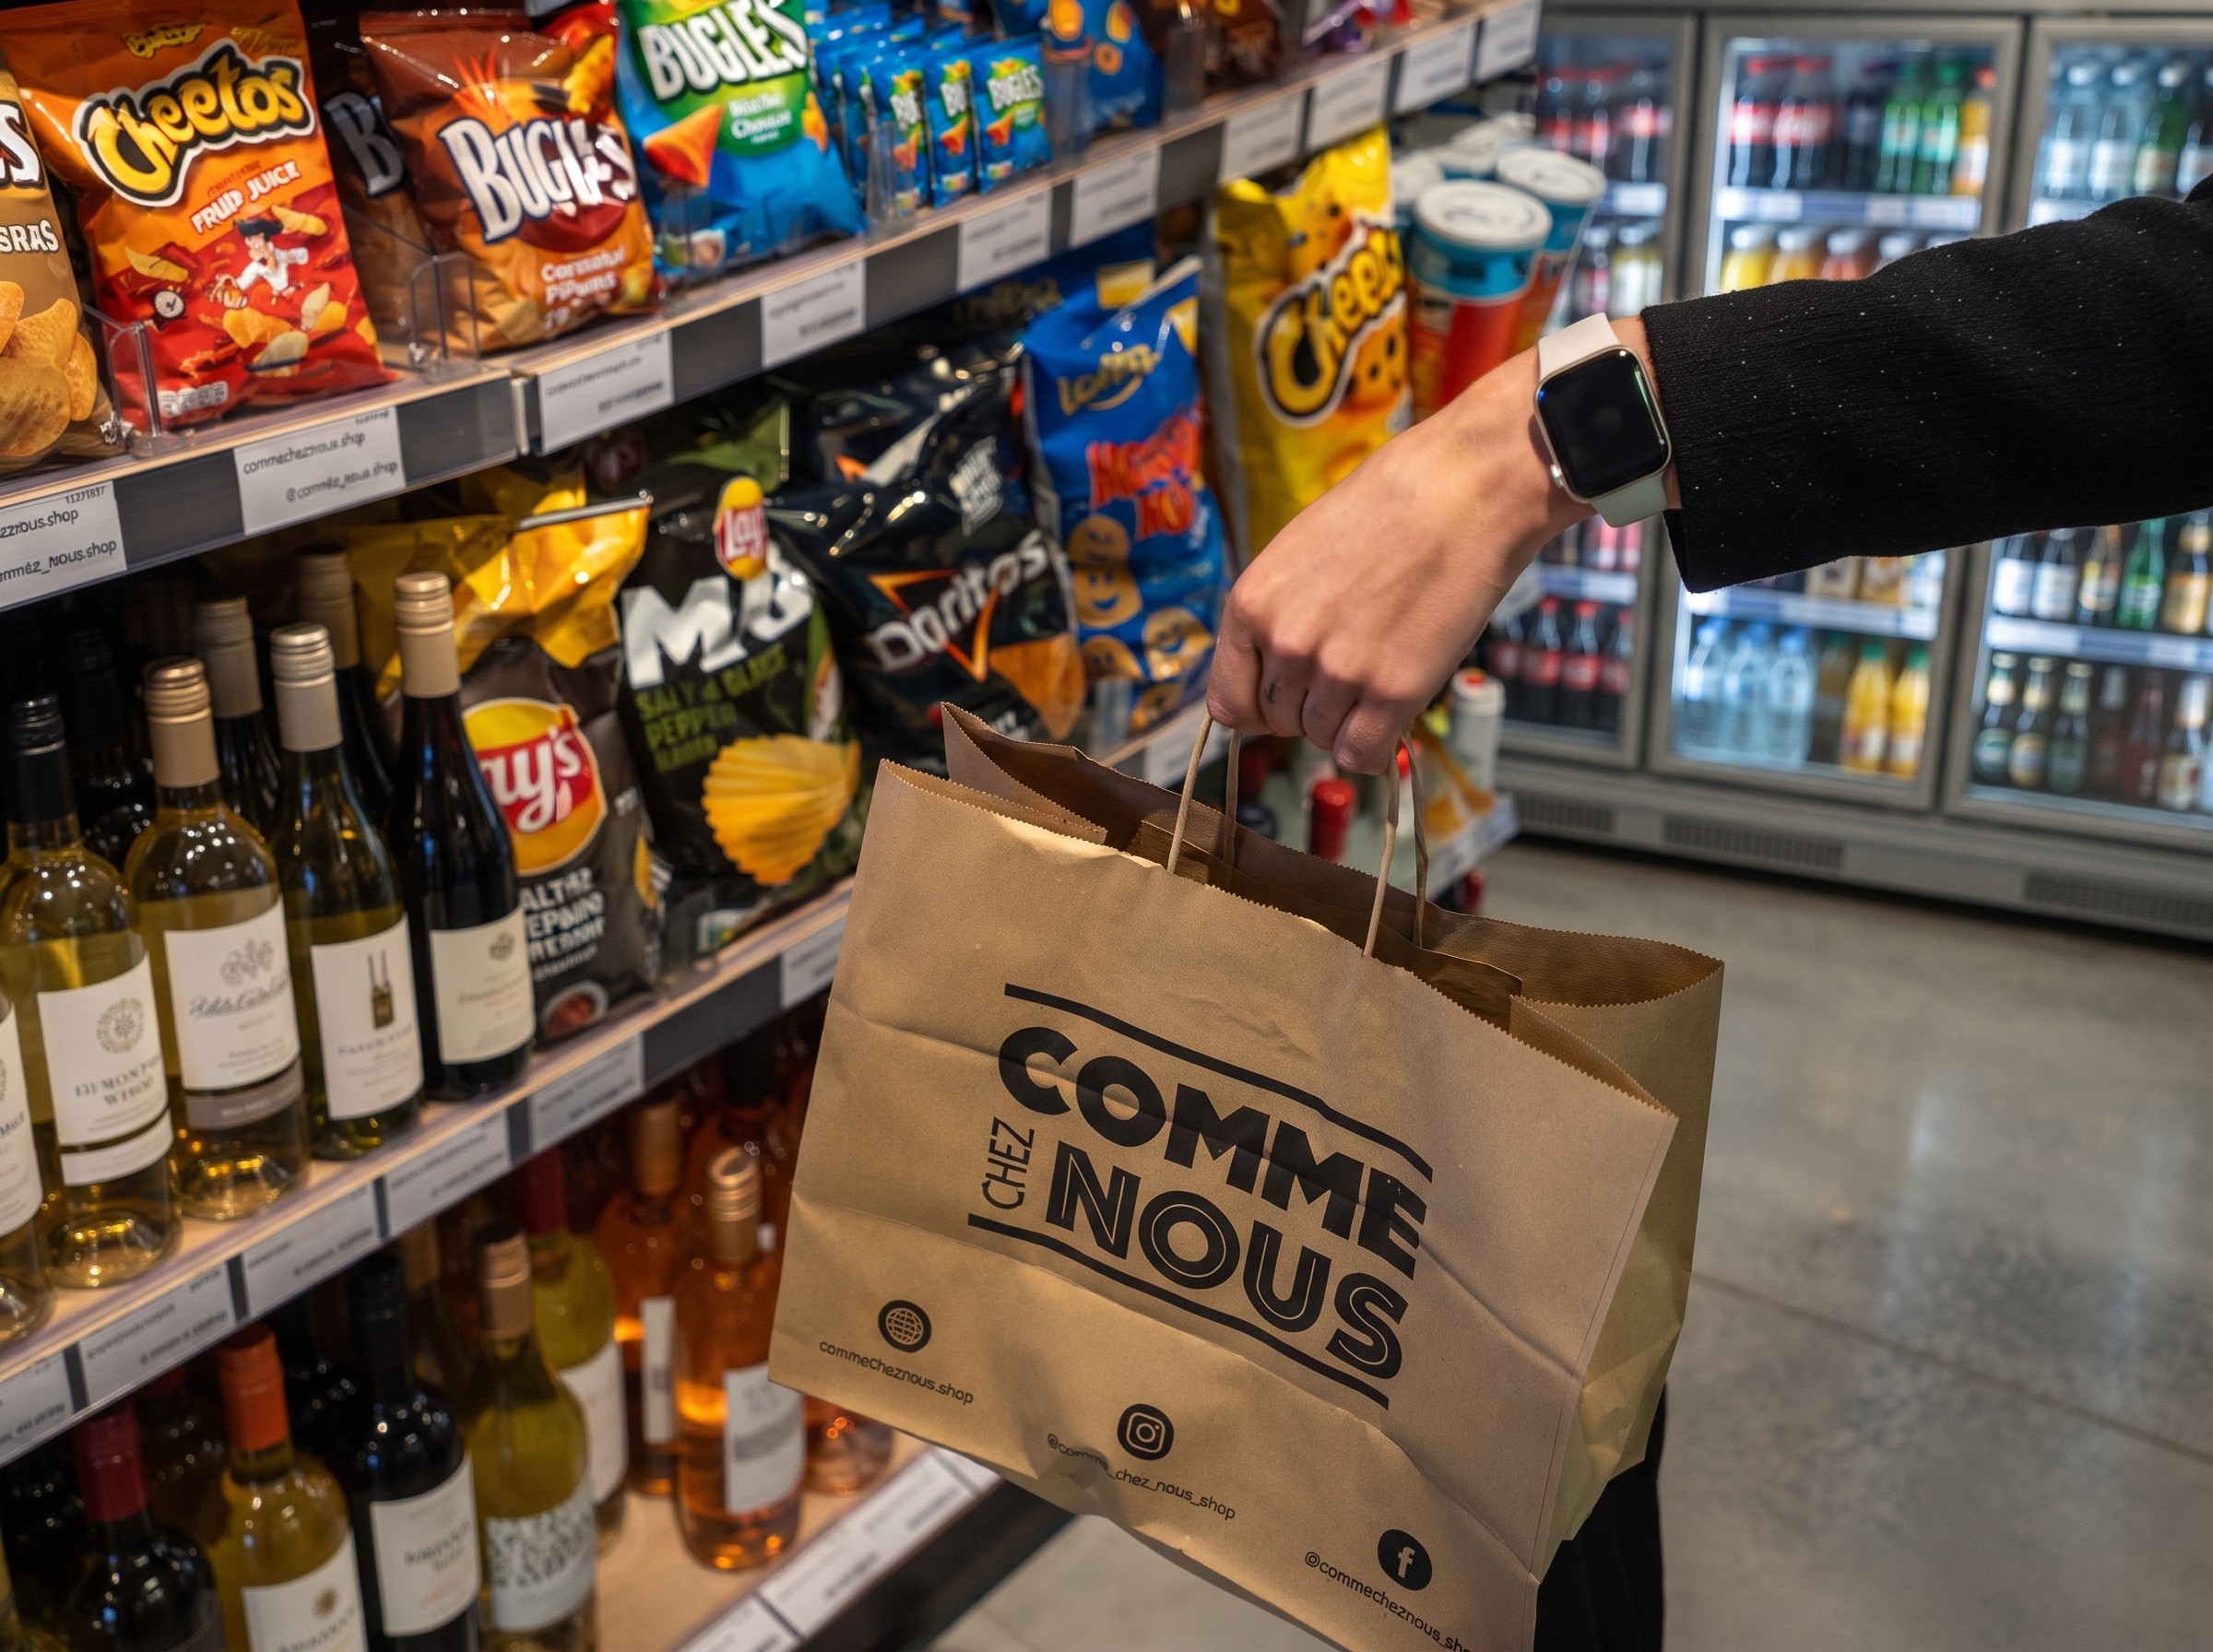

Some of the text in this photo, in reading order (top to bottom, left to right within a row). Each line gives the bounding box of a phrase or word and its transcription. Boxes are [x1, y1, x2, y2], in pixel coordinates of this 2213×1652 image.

[638, 0, 807, 100] BUGLES
[83, 46, 307, 195] Cheetos
[245, 159, 302, 202] JUICE
[866, 529, 1048, 673] Doritos
[480, 726, 582, 833] ay's
[982, 1116, 1035, 1210] CHEZ
[999, 1026, 1427, 1281] COMME
[1045, 1140, 1409, 1380] NOUS
